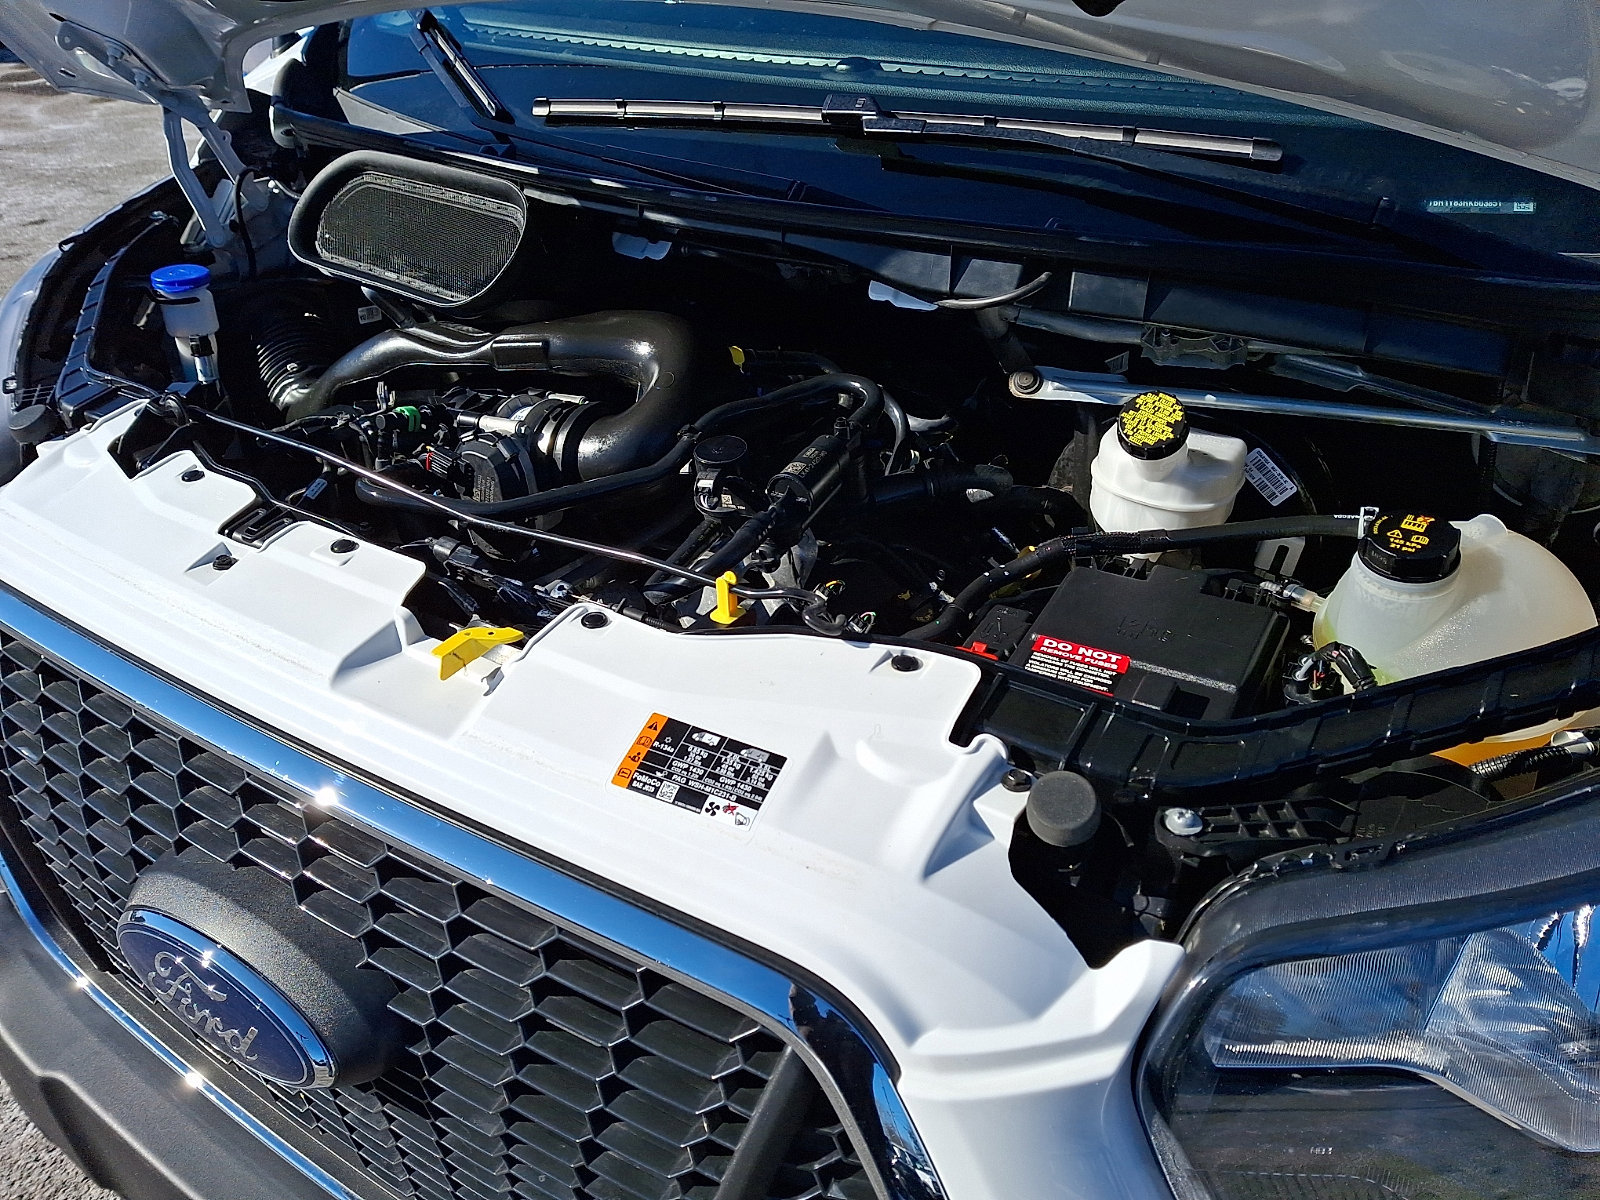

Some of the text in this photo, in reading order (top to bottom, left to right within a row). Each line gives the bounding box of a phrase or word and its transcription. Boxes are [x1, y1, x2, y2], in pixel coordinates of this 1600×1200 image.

[1040, 647, 1118, 669] REMOVE FUSES
[1043, 639, 1121, 662] DO NOT
[1033, 652, 1060, 661] REMOVAL
[1070, 660, 1088, 668] FUSES
[1029, 659, 1059, 670] VIOLATORS
[1060, 667, 1073, 675] WILL
[1084, 673, 1112, 684] CHARGED
[1058, 674, 1072, 682] WITH
[652, 741, 675, 752] R-134a
[698, 750, 708, 758] kg
[671, 759, 704, 775] GWP 1430
[632, 772, 662, 787] FoMoCo
[671, 774, 686, 783] PAG
[718, 776, 752, 791] GWP 1430
[763, 772, 773, 780] kg
[147, 951, 259, 1062] Ford
